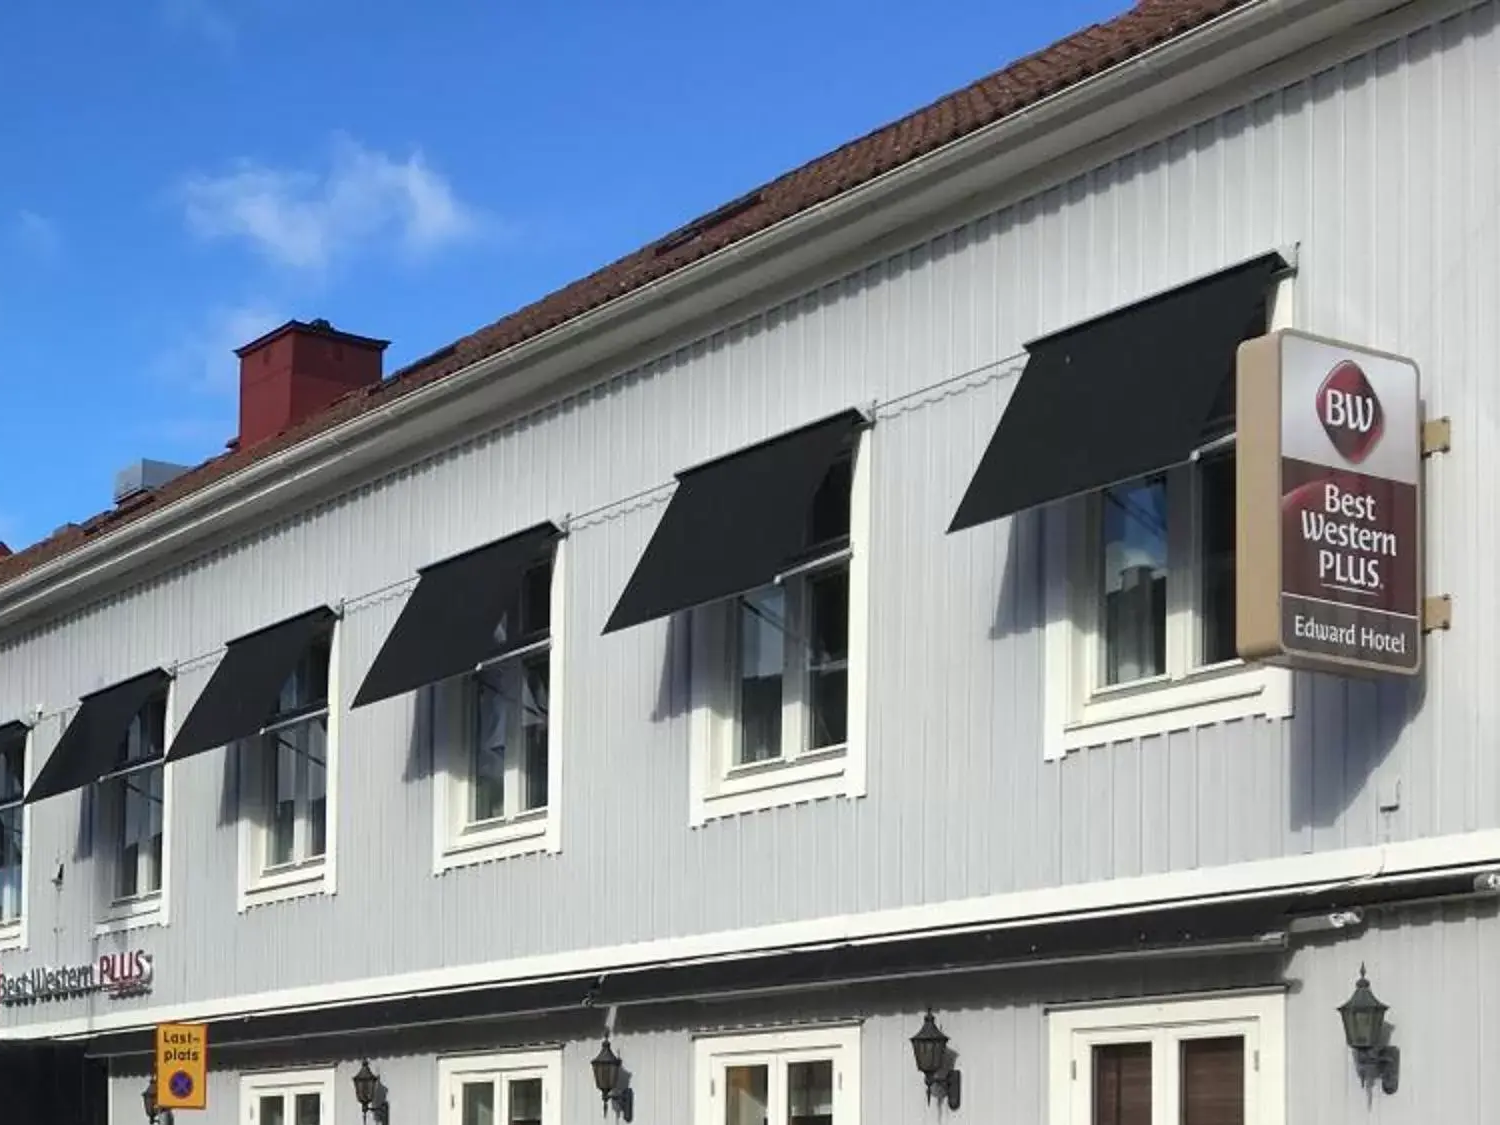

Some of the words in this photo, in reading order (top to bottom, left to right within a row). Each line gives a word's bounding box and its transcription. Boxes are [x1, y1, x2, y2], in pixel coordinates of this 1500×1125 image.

[1326, 388, 1373, 432] BW
[1324, 483, 1376, 521] Best
[1301, 510, 1397, 557] Western
[1295, 615, 1356, 646] Edward
[1361, 627, 1406, 653] Hotel
[0, 973, 31, 998] Best
[31, 963, 95, 992] Western
[100, 950, 146, 983] PLUS
[163, 1031, 200, 1044] Last-
[164, 1048, 199, 1062] plats
